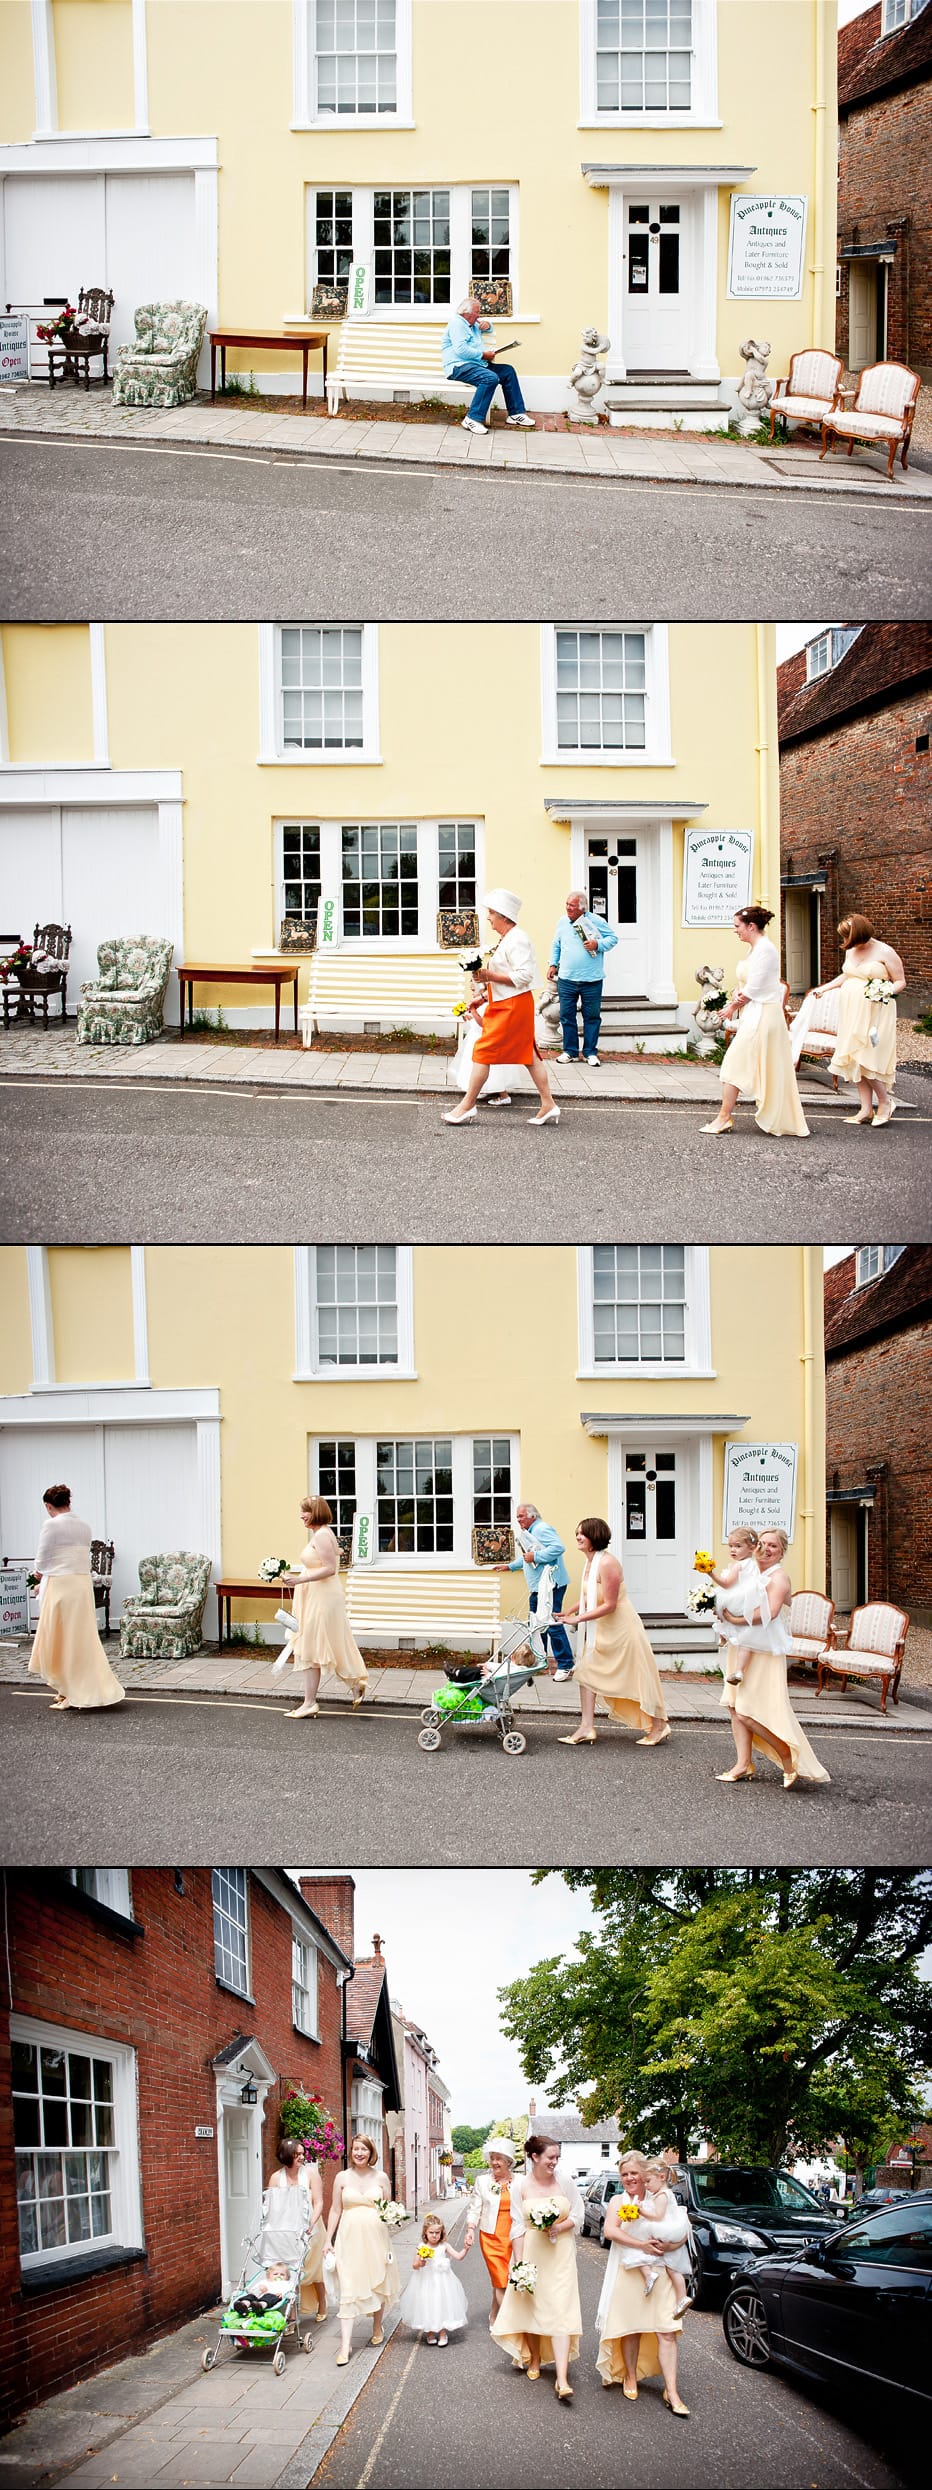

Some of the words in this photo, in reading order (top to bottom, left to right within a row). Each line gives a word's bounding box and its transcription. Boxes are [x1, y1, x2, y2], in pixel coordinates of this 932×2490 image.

[736, 199, 776, 220] Pineapple
[779, 201, 802, 220] House
[749, 225, 788, 237] Antiques
[650, 236, 659, 244] 49
[746, 240, 773, 248] Antiques
[774, 240, 786, 248] and
[745, 261, 766, 271] Bought
[774, 261, 788, 269] Sold
[353, 267, 366, 309] OPEN
[2, 357, 22, 368] Open
[690, 834, 726, 853] Pineapple
[728, 835, 749, 853] House
[701, 858, 737, 869] Antiques
[609, 868, 618, 876] 49
[699, 872, 724, 880] Antiques
[698, 892, 718, 900] Bought
[322, 900, 335, 942] OPEN
[731, 1448, 769, 1467] Pineapple
[771, 1448, 793, 1468] House
[742, 1472, 780, 1483] Antiques
[646, 1483, 656, 1491] 49
[740, 1486, 766, 1494] Antiques
[739, 1507, 759, 1515] Bought
[357, 1516, 369, 1558] OPEN
